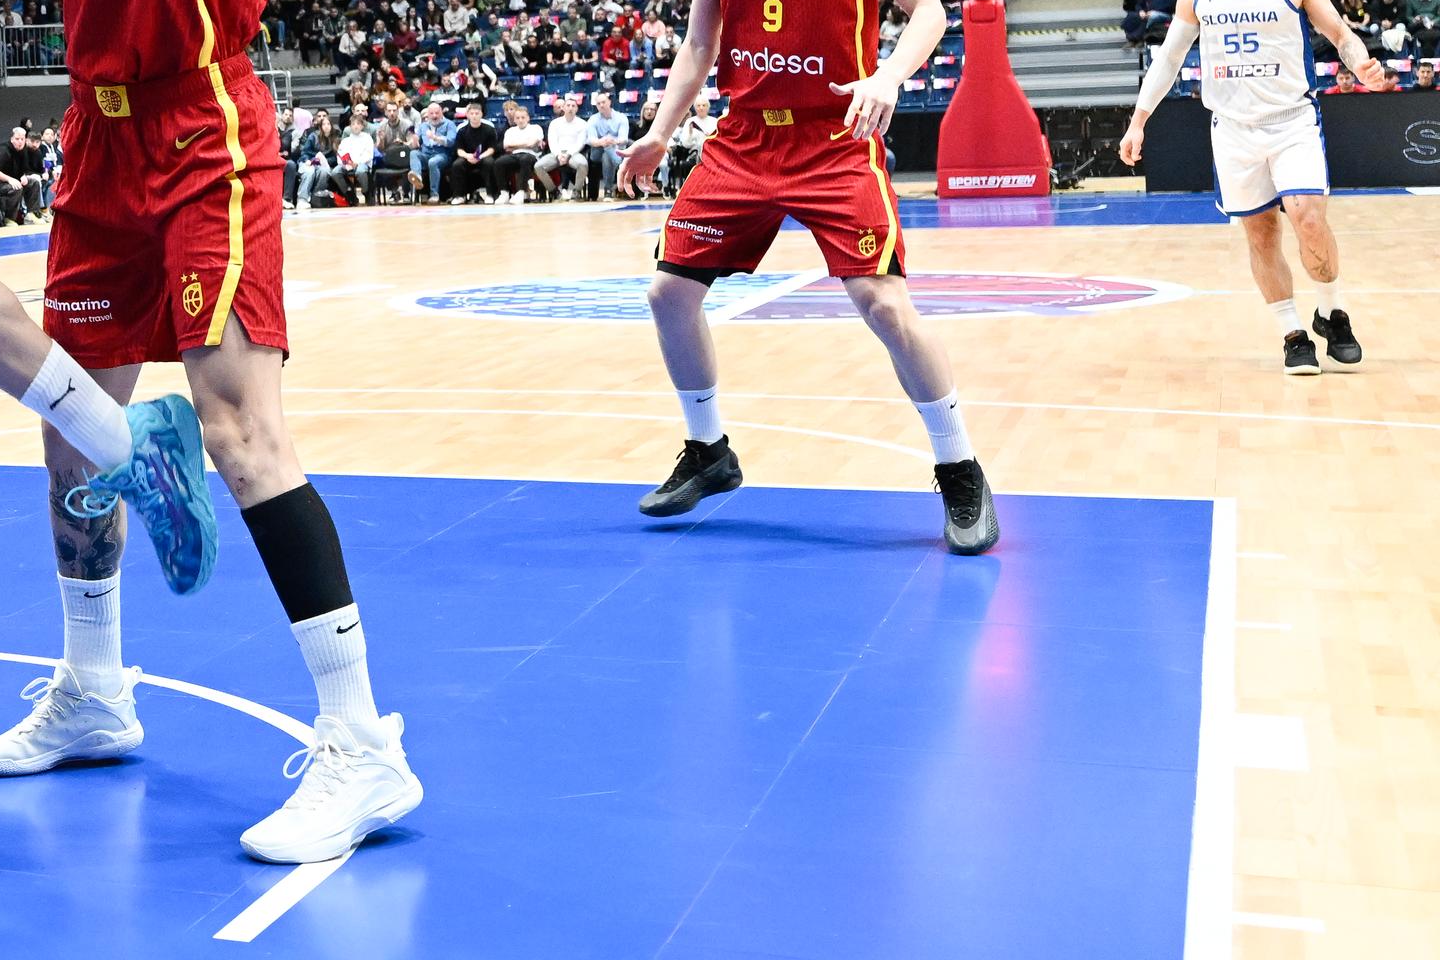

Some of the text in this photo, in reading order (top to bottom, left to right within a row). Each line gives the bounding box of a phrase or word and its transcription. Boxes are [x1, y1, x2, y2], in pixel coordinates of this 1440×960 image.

[1201, 10, 1279, 26] SLOVAKIA
[1223, 32, 1260, 54] 55
[730, 47, 824, 75] endesa
[1228, 64, 1277, 78] TIPOS
[668, 219, 724, 236] azulmarino
[69, 316, 87, 324] new
